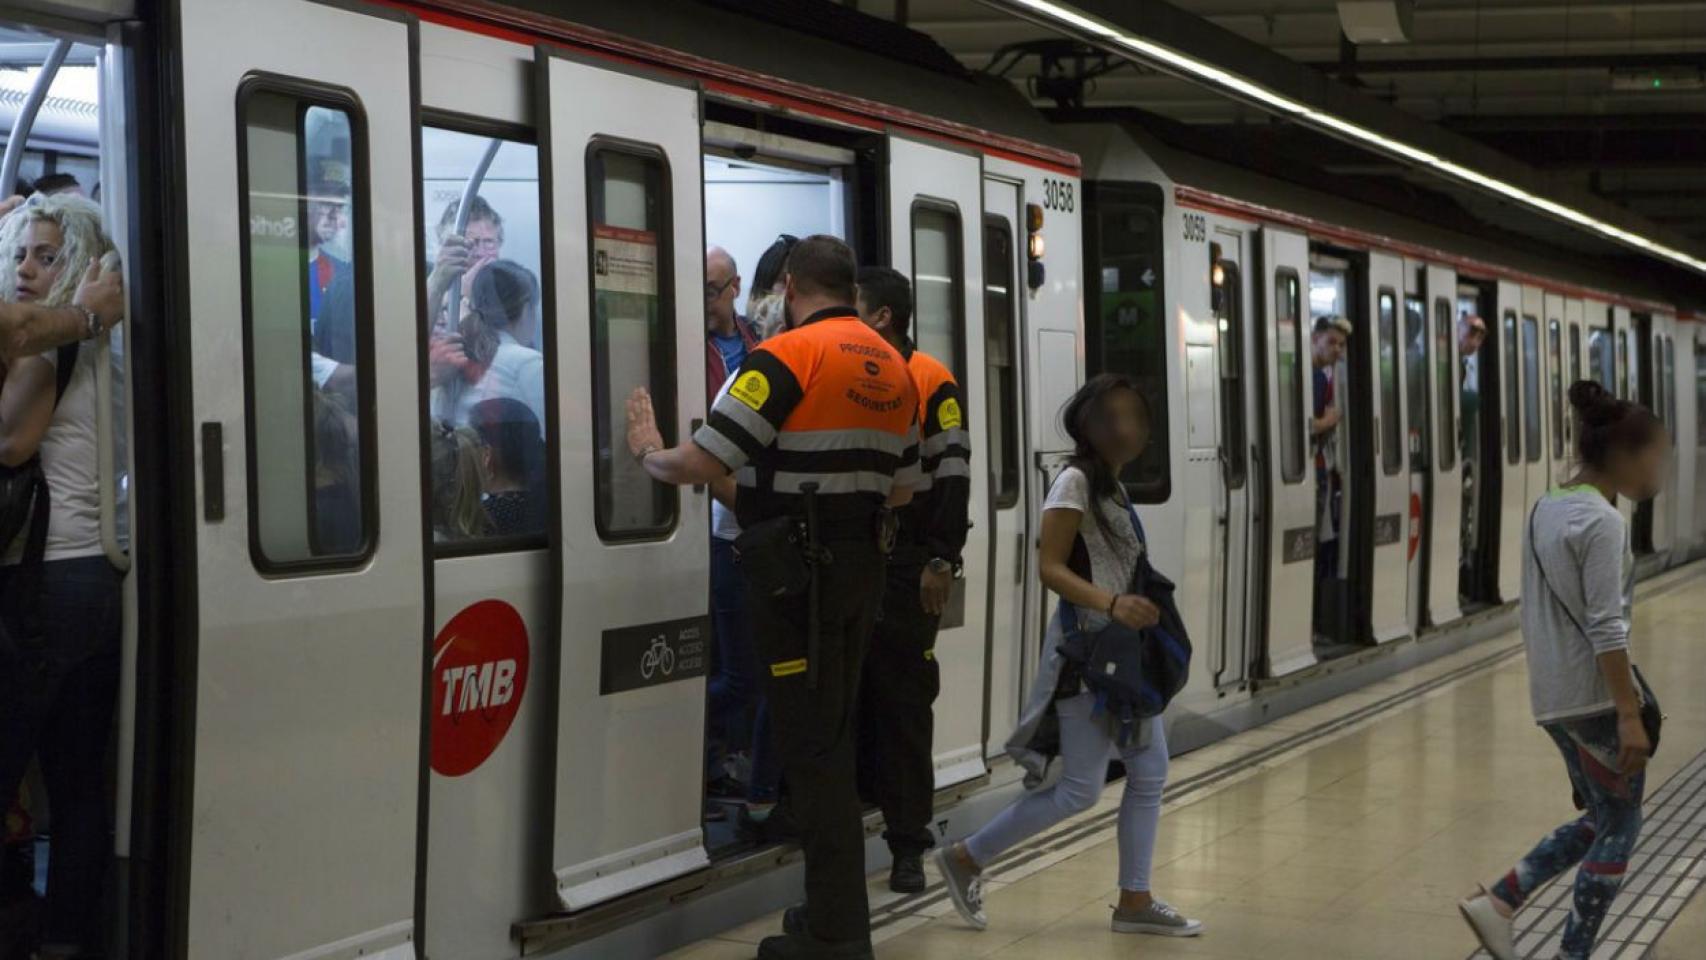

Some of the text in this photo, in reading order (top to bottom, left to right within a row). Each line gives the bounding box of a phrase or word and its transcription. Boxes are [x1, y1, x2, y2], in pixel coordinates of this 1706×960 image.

[1043, 178, 1075, 213] 3058
[1182, 212, 1206, 242] 3059
[839, 343, 893, 360] PROSEGUR
[442, 659, 517, 716] TMB
